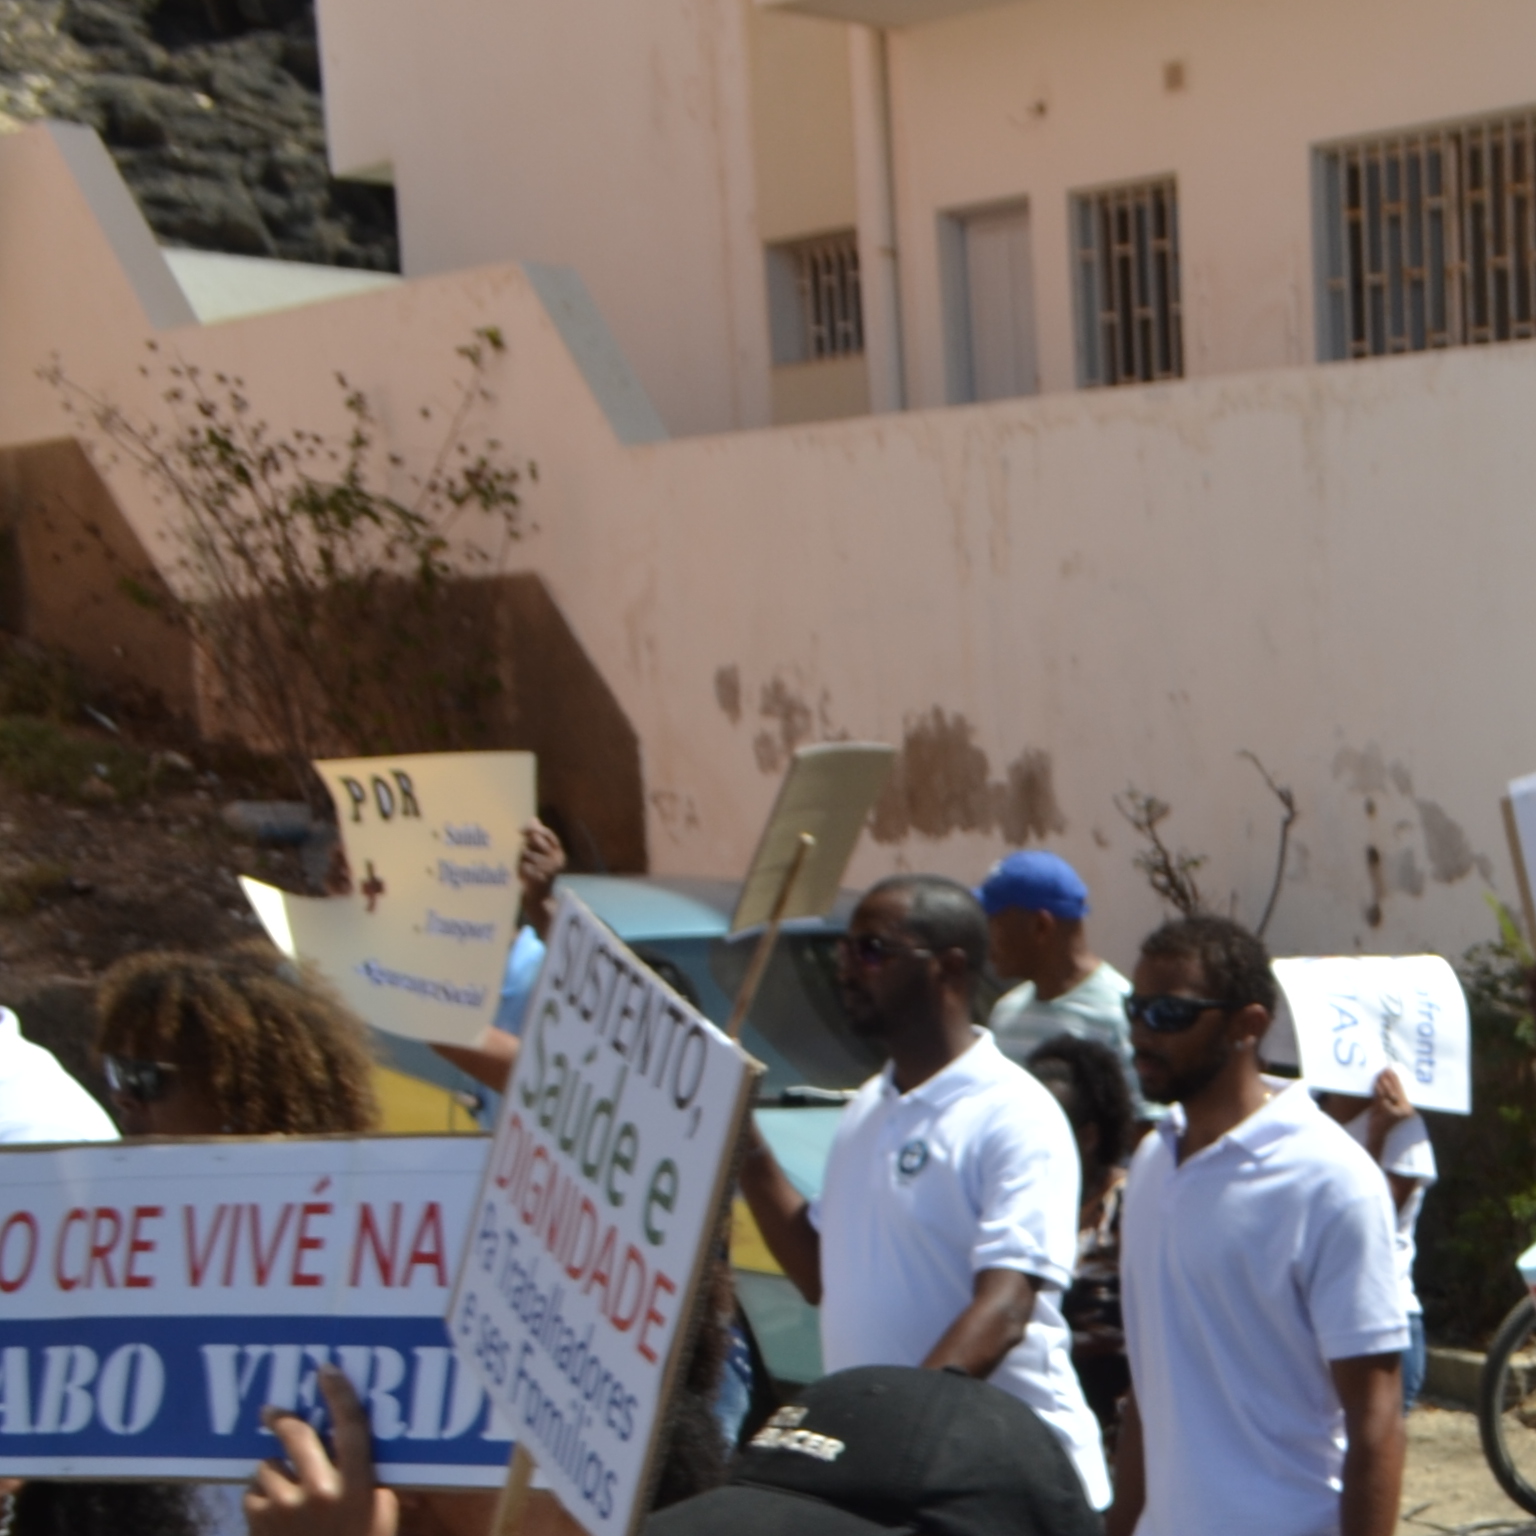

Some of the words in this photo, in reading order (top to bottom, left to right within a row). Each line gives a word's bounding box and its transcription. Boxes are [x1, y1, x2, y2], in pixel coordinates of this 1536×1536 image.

[339, 769, 421, 822] POR
[522, 999, 639, 1208] Saúde
[642, 1157, 680, 1247] e
[553, 914, 707, 1139] SUSTENTO,
[55, 1205, 165, 1291] CRE
[183, 1176, 333, 1288] VIVÉ
[350, 1202, 449, 1288] NA
[495, 1112, 677, 1363] DIGNIDADE
